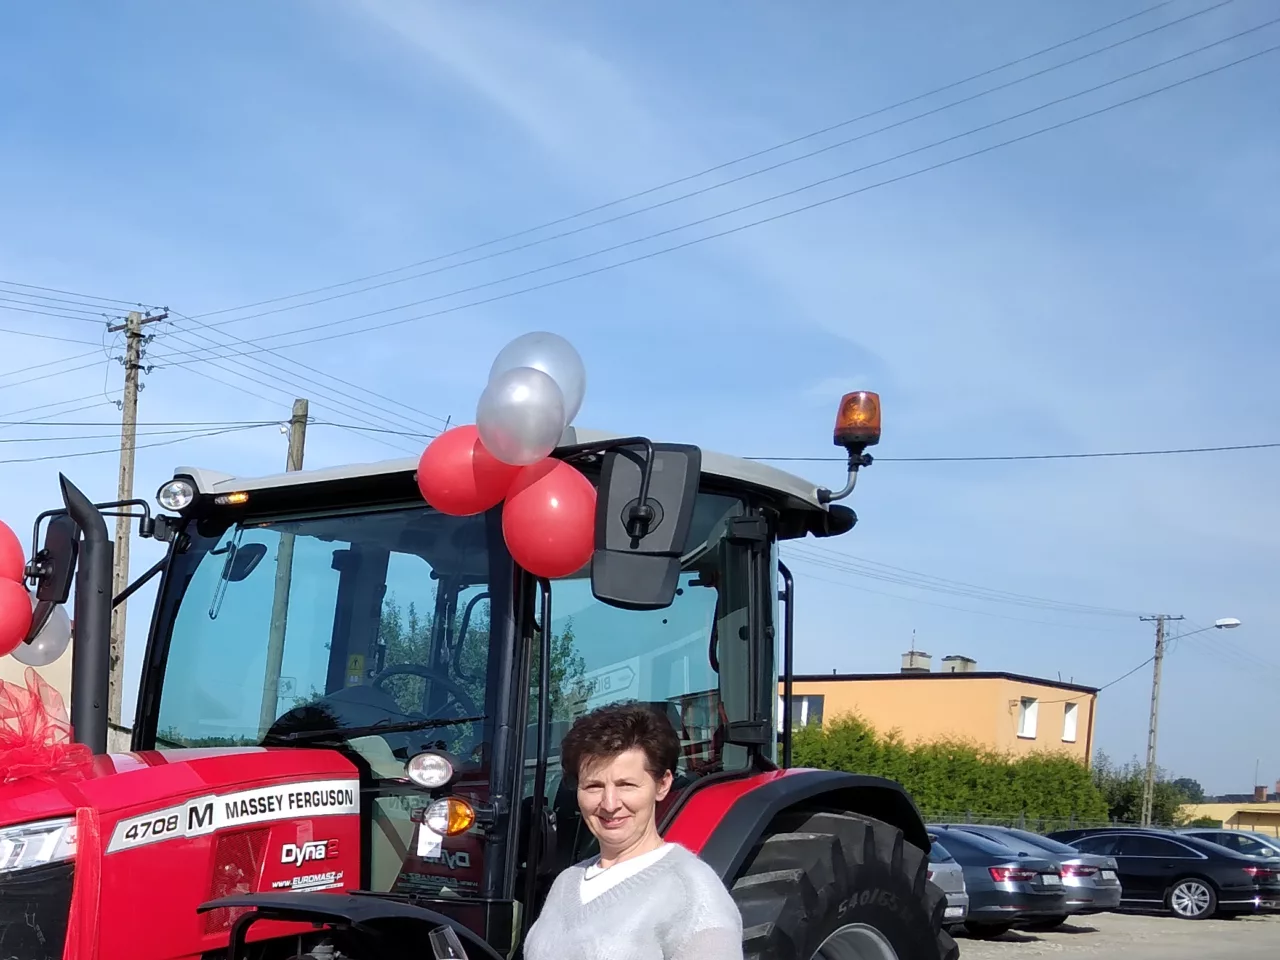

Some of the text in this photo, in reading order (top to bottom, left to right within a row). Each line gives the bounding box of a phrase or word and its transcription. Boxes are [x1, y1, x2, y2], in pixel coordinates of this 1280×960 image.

[124, 789, 354, 841] 4708 M MASSEY FERGUSON
